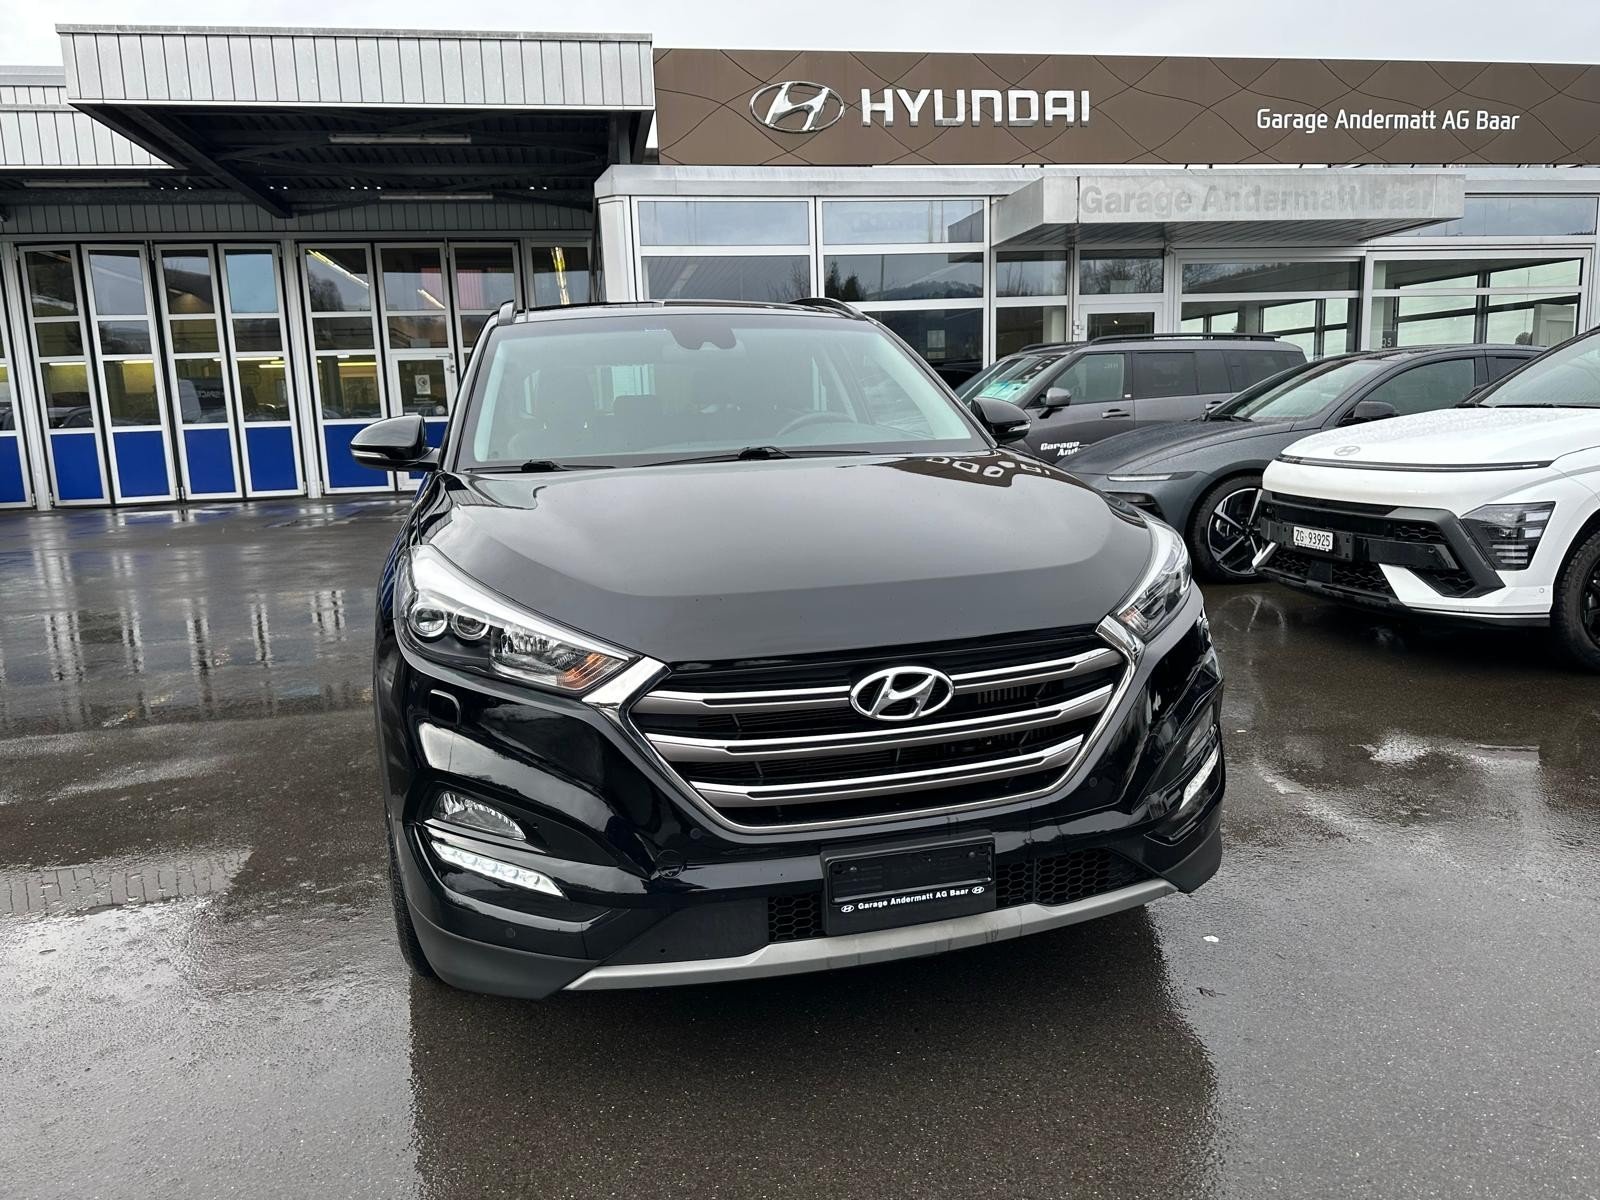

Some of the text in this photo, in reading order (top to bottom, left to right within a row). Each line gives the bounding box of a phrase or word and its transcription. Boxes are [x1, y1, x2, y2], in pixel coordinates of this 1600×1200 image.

[861, 88, 1090, 127] HYUNDAI
[1257, 108, 1520, 134] Garage Andermatt AG Baar
[1080, 185, 1193, 219] Garage
[1040, 441, 1080, 451] Garage
[858, 888, 969, 910] Garage Andermatt AG Baar
